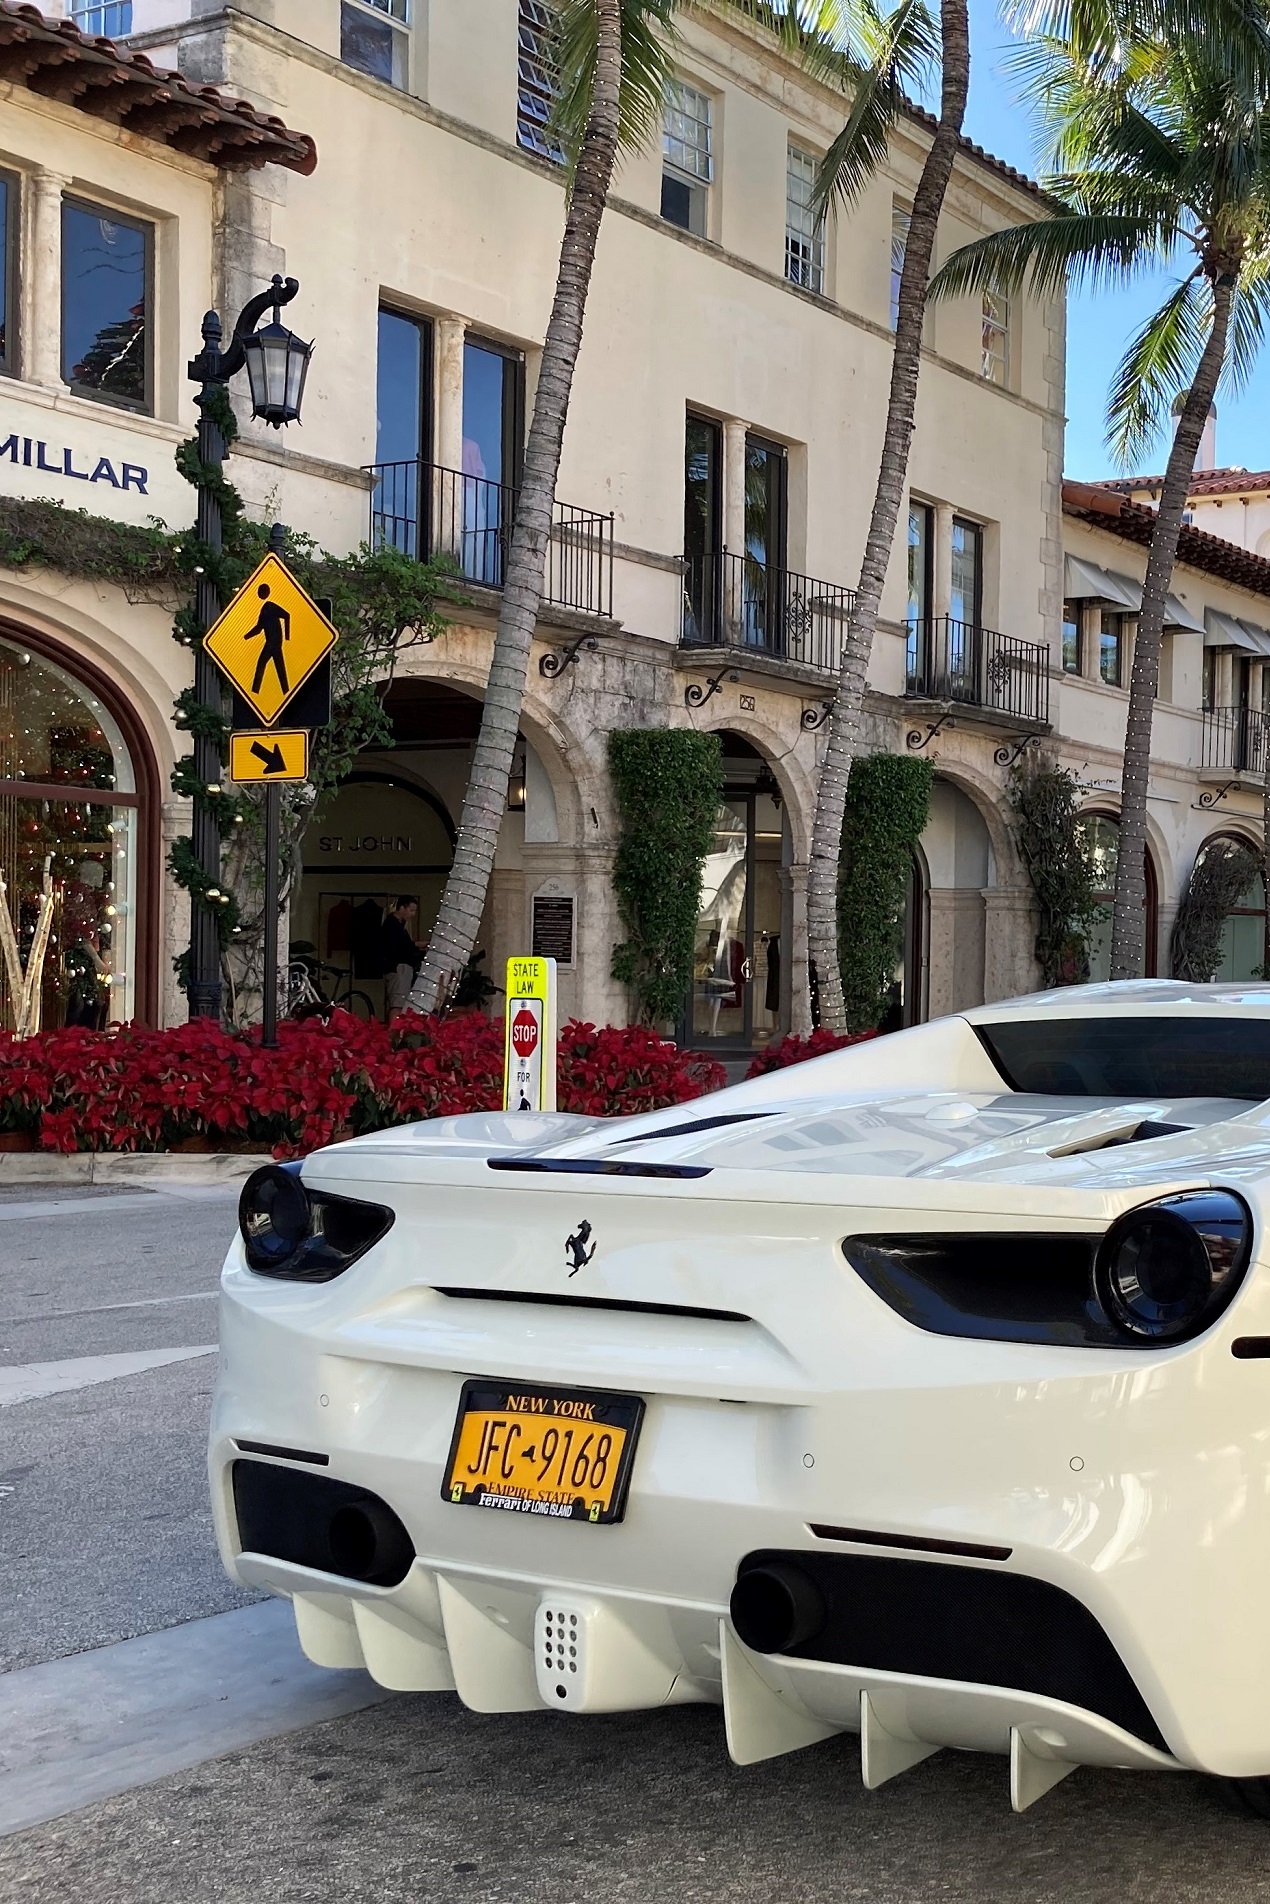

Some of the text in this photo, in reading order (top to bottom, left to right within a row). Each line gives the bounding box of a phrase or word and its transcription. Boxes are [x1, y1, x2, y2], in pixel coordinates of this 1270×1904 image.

[349, 836, 411, 852] JOHN
[513, 963, 539, 977] STATE
[516, 981, 534, 994] LAW
[513, 1025, 537, 1042] STOP
[517, 1072, 531, 1082] FOR
[505, 1394, 596, 1421] NEW YORK
[467, 1420, 613, 1490] JFC 9168
[487, 1482, 576, 1505] EMPIRE STATE
[478, 1493, 573, 1518] Ferrari OF LONG ISLAND
